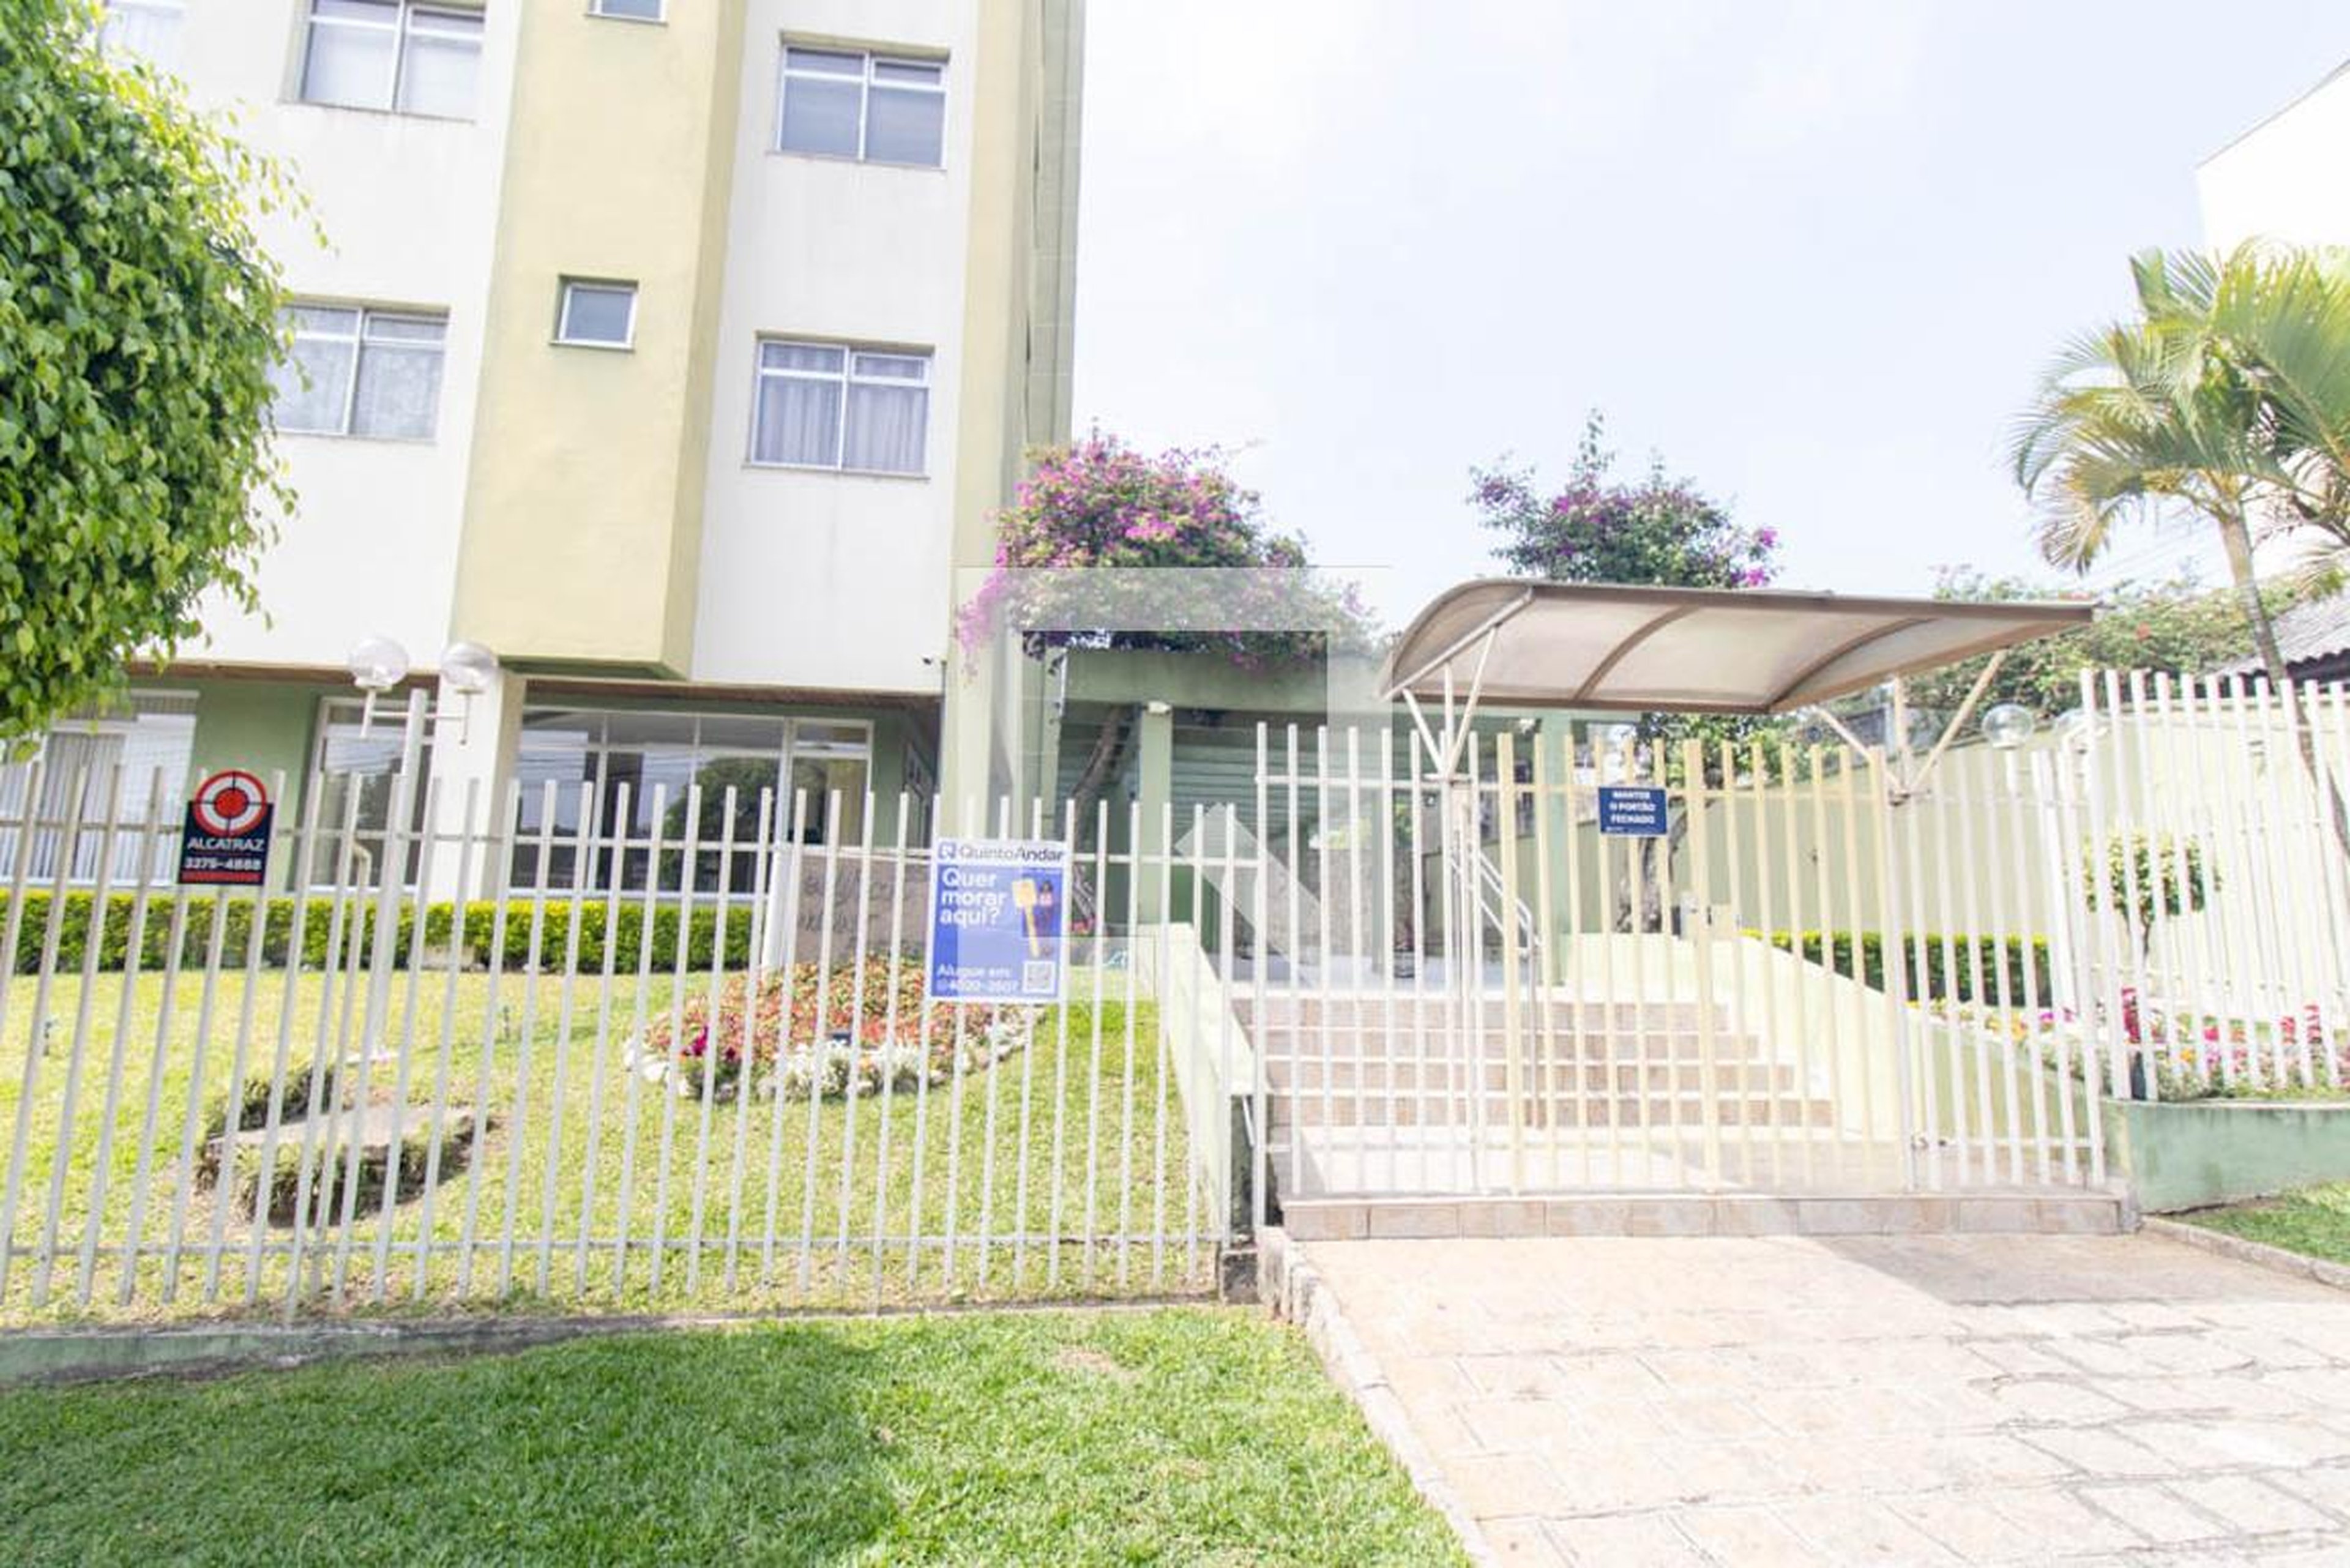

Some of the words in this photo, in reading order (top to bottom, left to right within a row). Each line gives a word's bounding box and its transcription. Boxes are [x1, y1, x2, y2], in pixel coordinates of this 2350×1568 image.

[187, 837, 265, 851] ALCATRAZ
[959, 844, 1063, 862] QuintoAndar
[942, 867, 997, 888] Quer
[941, 891, 1009, 906] morar
[939, 906, 1000, 928] aqui?
